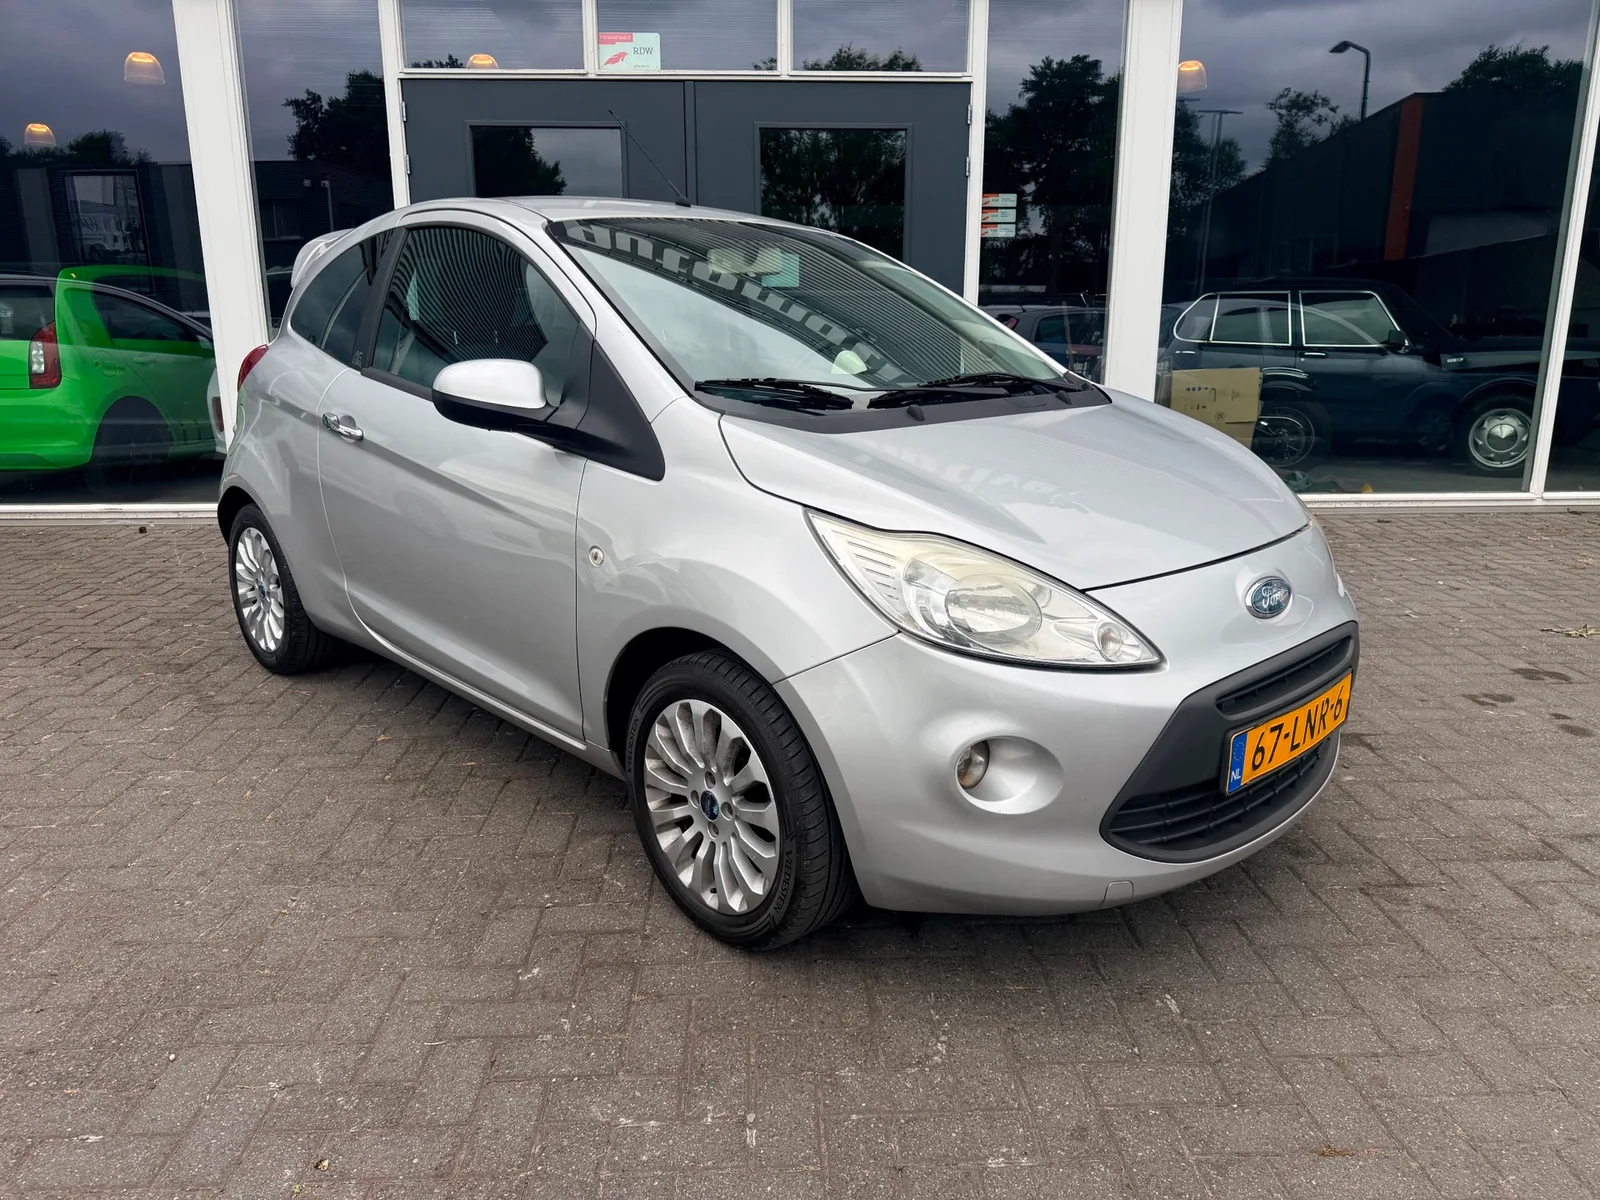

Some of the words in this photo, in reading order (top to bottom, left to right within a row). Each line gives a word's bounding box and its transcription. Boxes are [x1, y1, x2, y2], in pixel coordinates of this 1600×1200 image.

[632, 46, 654, 55] RDW
[1251, 684, 1344, 771] 67-LNR-6
[1230, 767, 1241, 782] NL
[773, 850, 793, 914] VREDESTEIN
